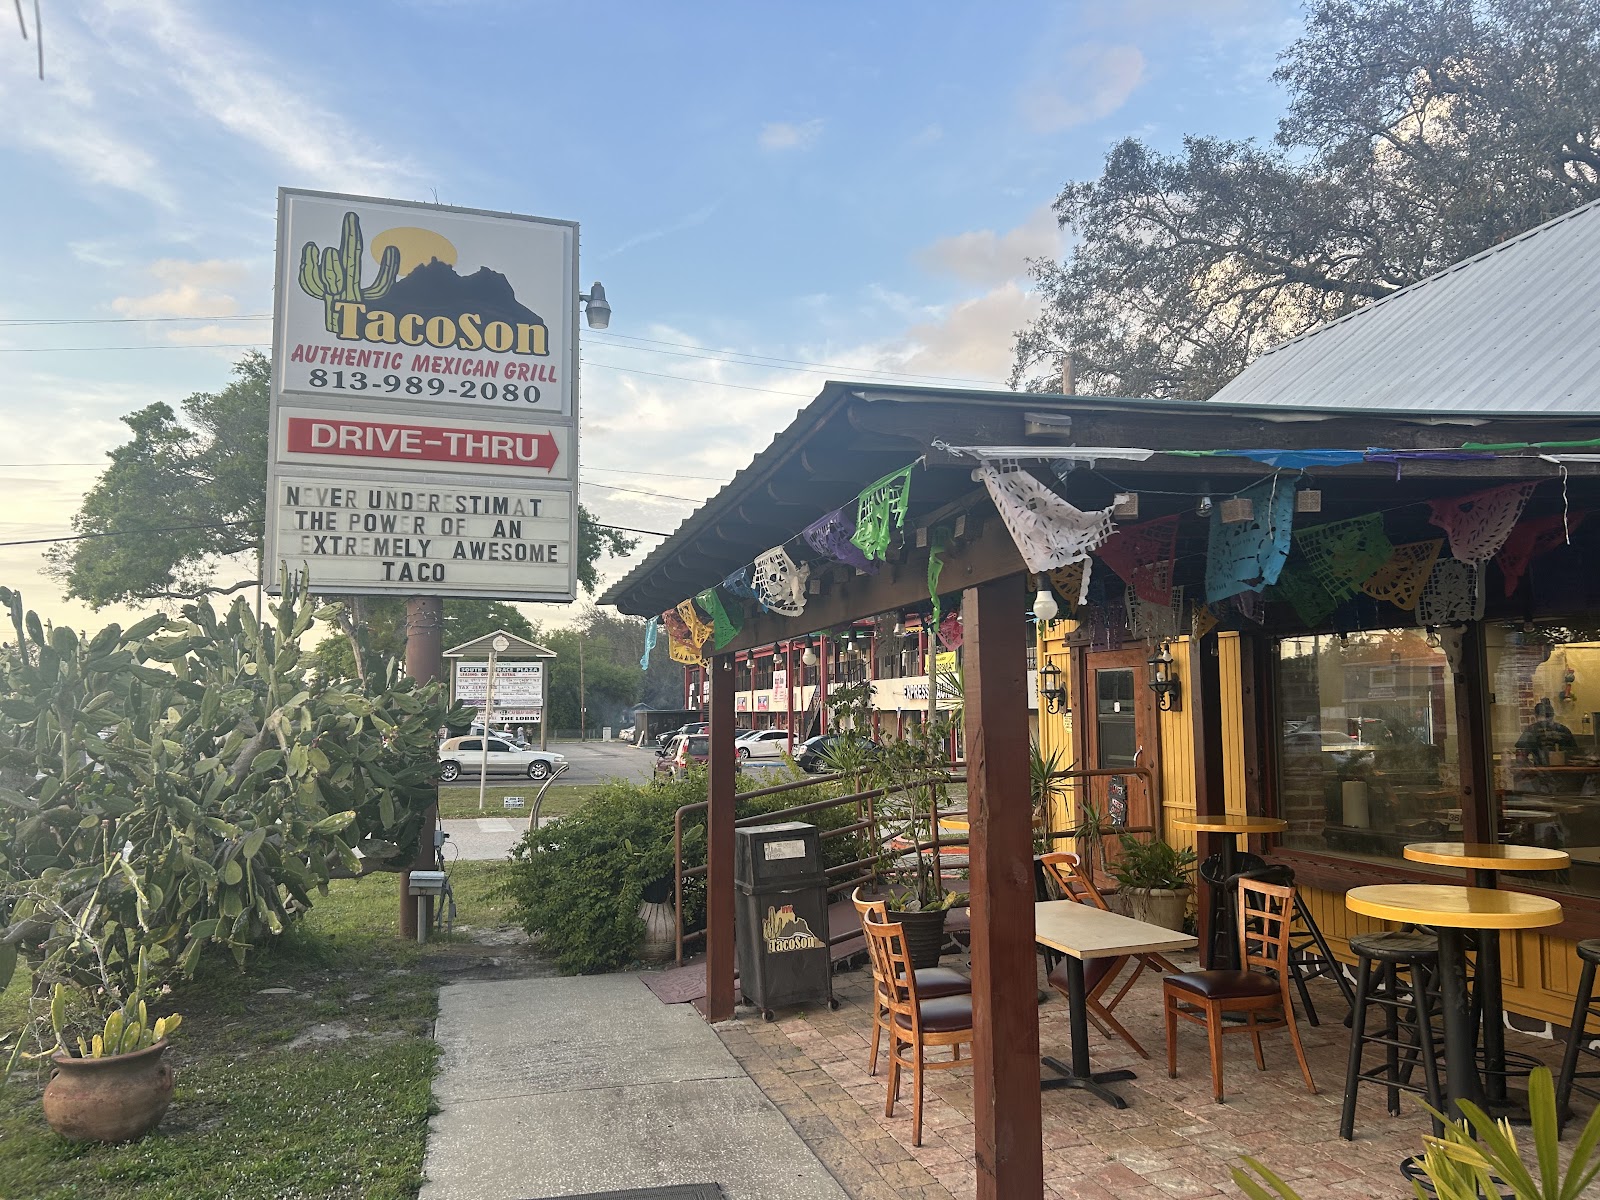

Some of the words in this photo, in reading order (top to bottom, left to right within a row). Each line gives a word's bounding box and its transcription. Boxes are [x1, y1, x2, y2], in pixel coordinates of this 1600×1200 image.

[335, 300, 550, 356] TacoSon
[291, 344, 403, 370] AUTHENTIC
[411, 355, 499, 378] MEXICAN
[504, 362, 558, 383] GRILL
[308, 368, 541, 403] 813-989-2080
[311, 423, 539, 461] DRIVE-THRU
[286, 486, 357, 507] NEVER
[368, 489, 542, 516] UNDERESTIMAT
[295, 510, 336, 530] THE
[349, 512, 425, 535] POWER
[441, 517, 466, 536] OF
[493, 519, 522, 539] AN
[301, 535, 431, 558] EXTREMELY
[453, 540, 558, 563] AWESOME
[382, 561, 445, 582] TACO
